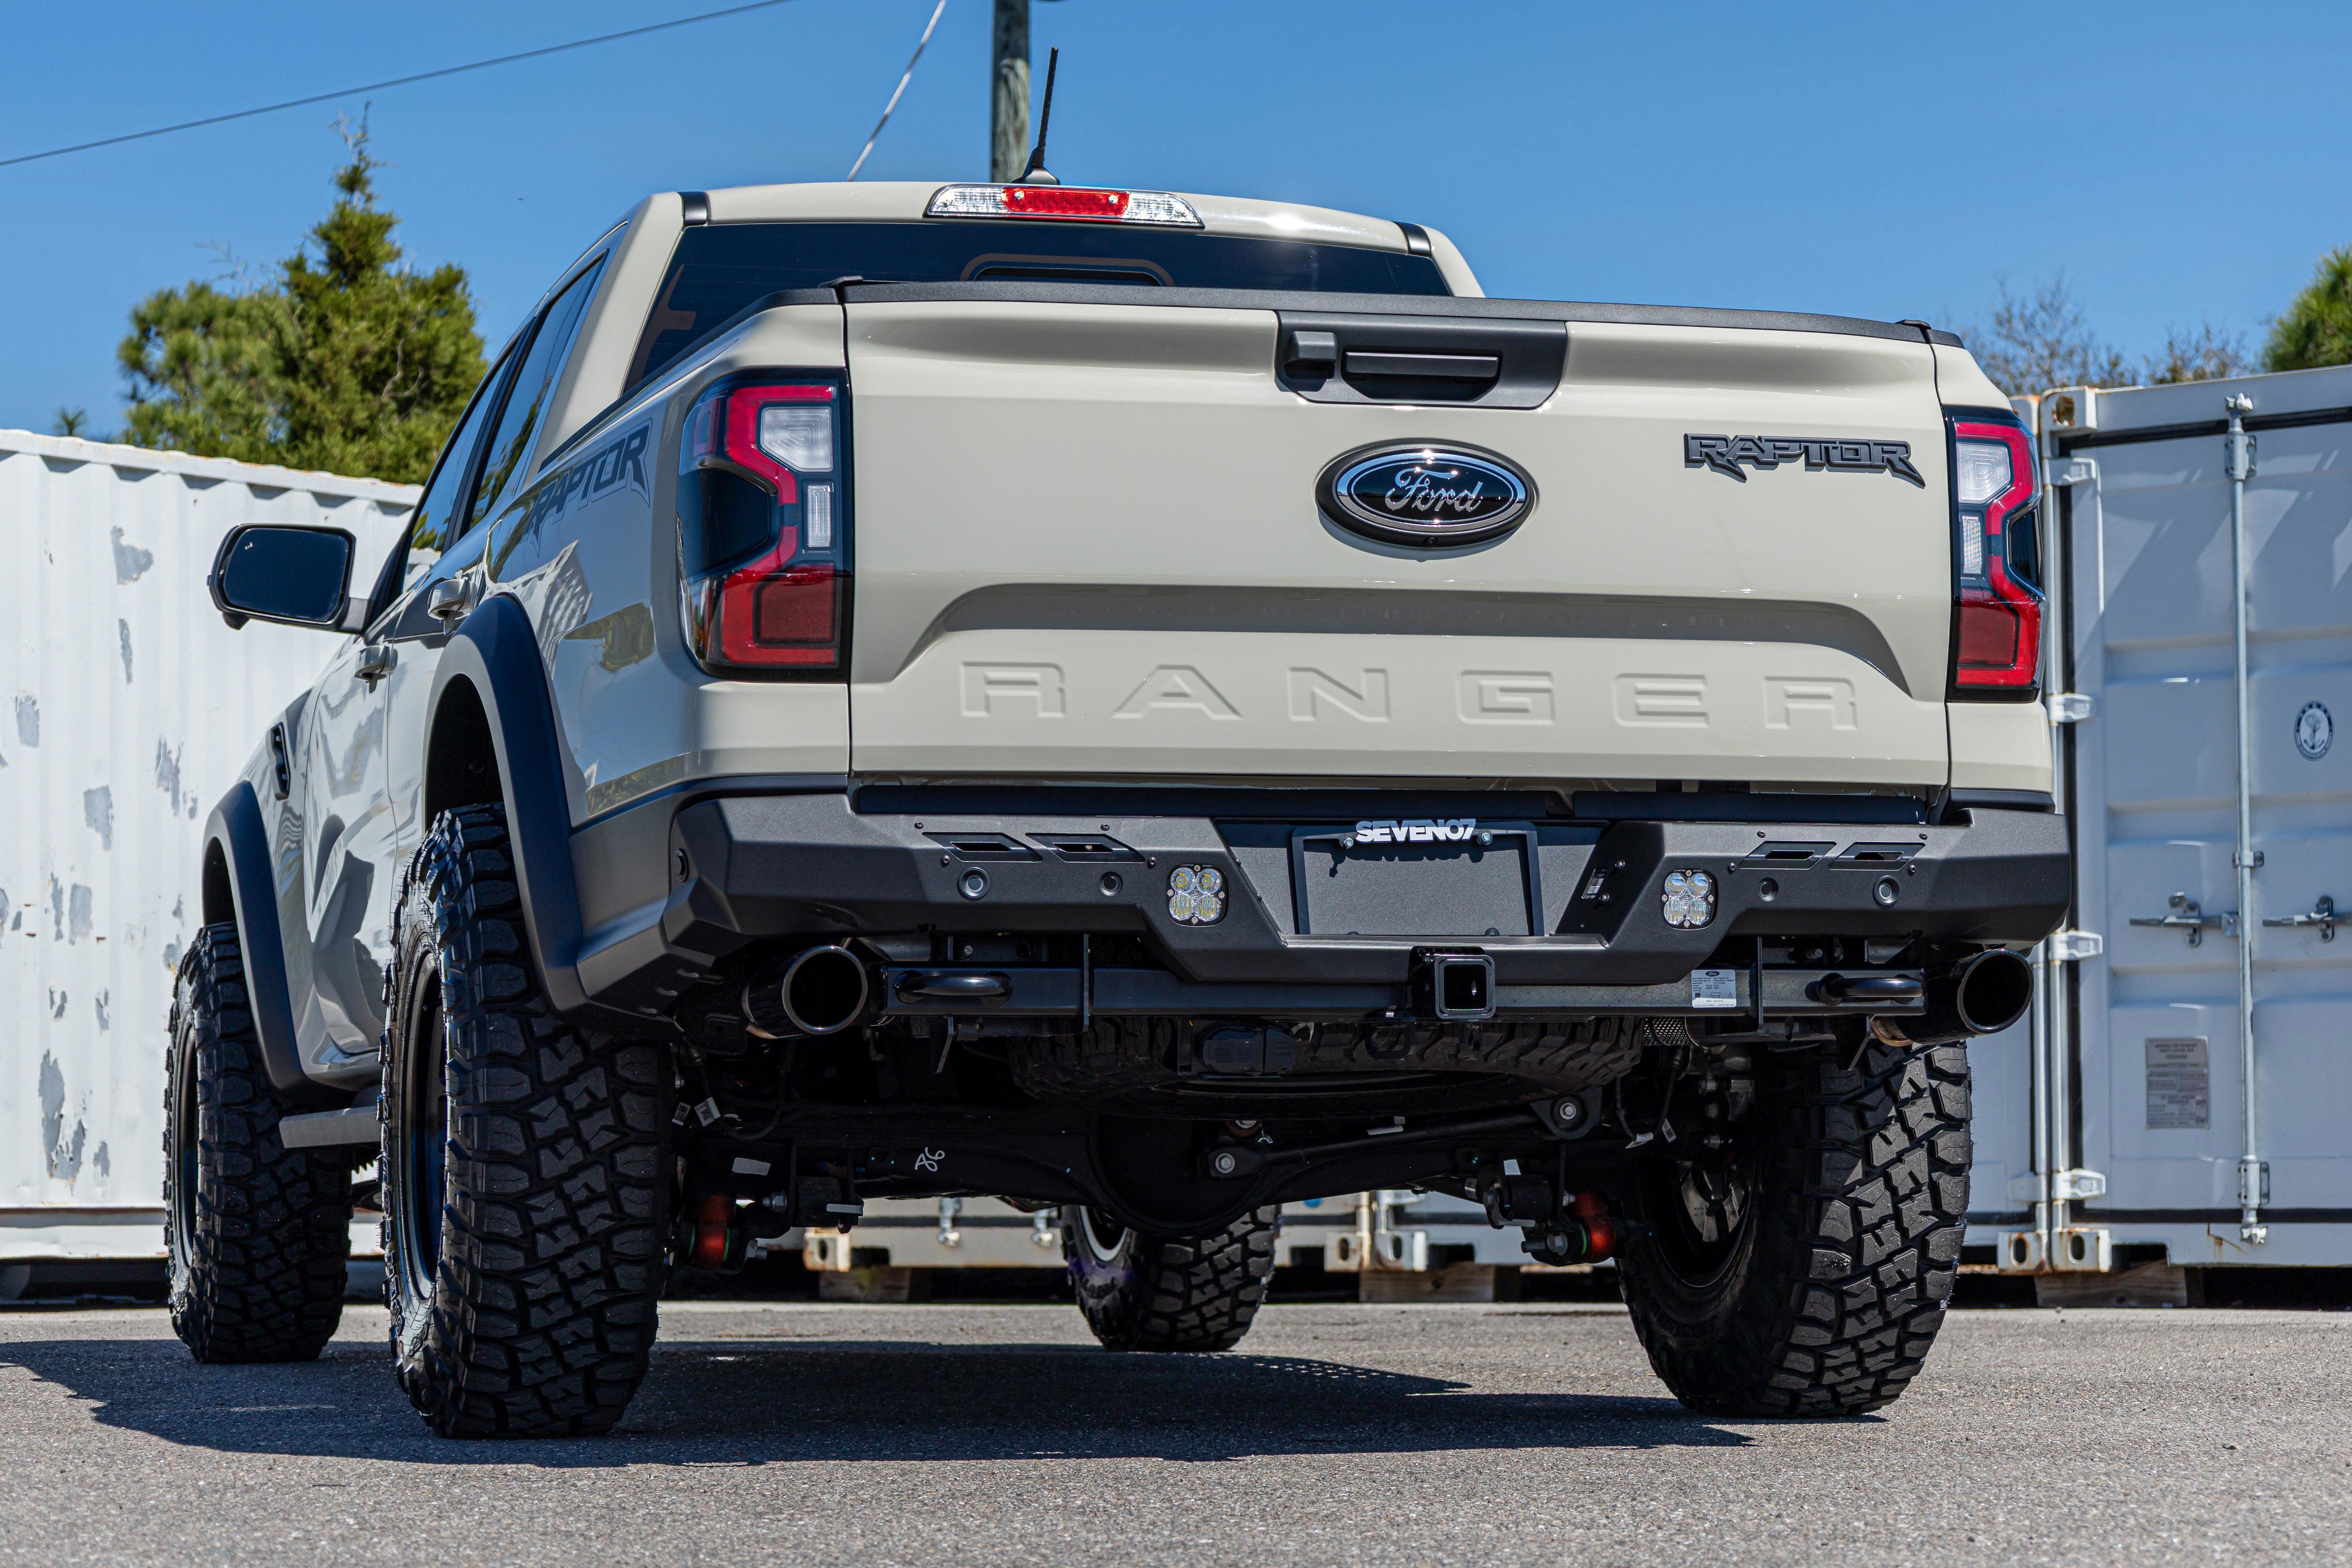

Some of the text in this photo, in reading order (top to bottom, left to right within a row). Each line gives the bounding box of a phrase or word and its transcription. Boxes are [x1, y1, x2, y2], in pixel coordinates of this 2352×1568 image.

[521, 419, 652, 555] RAPTOR
[1385, 467, 1483, 512] Ford
[1684, 433, 1926, 488] RAPTOR
[960, 661, 1858, 730] RANGER
